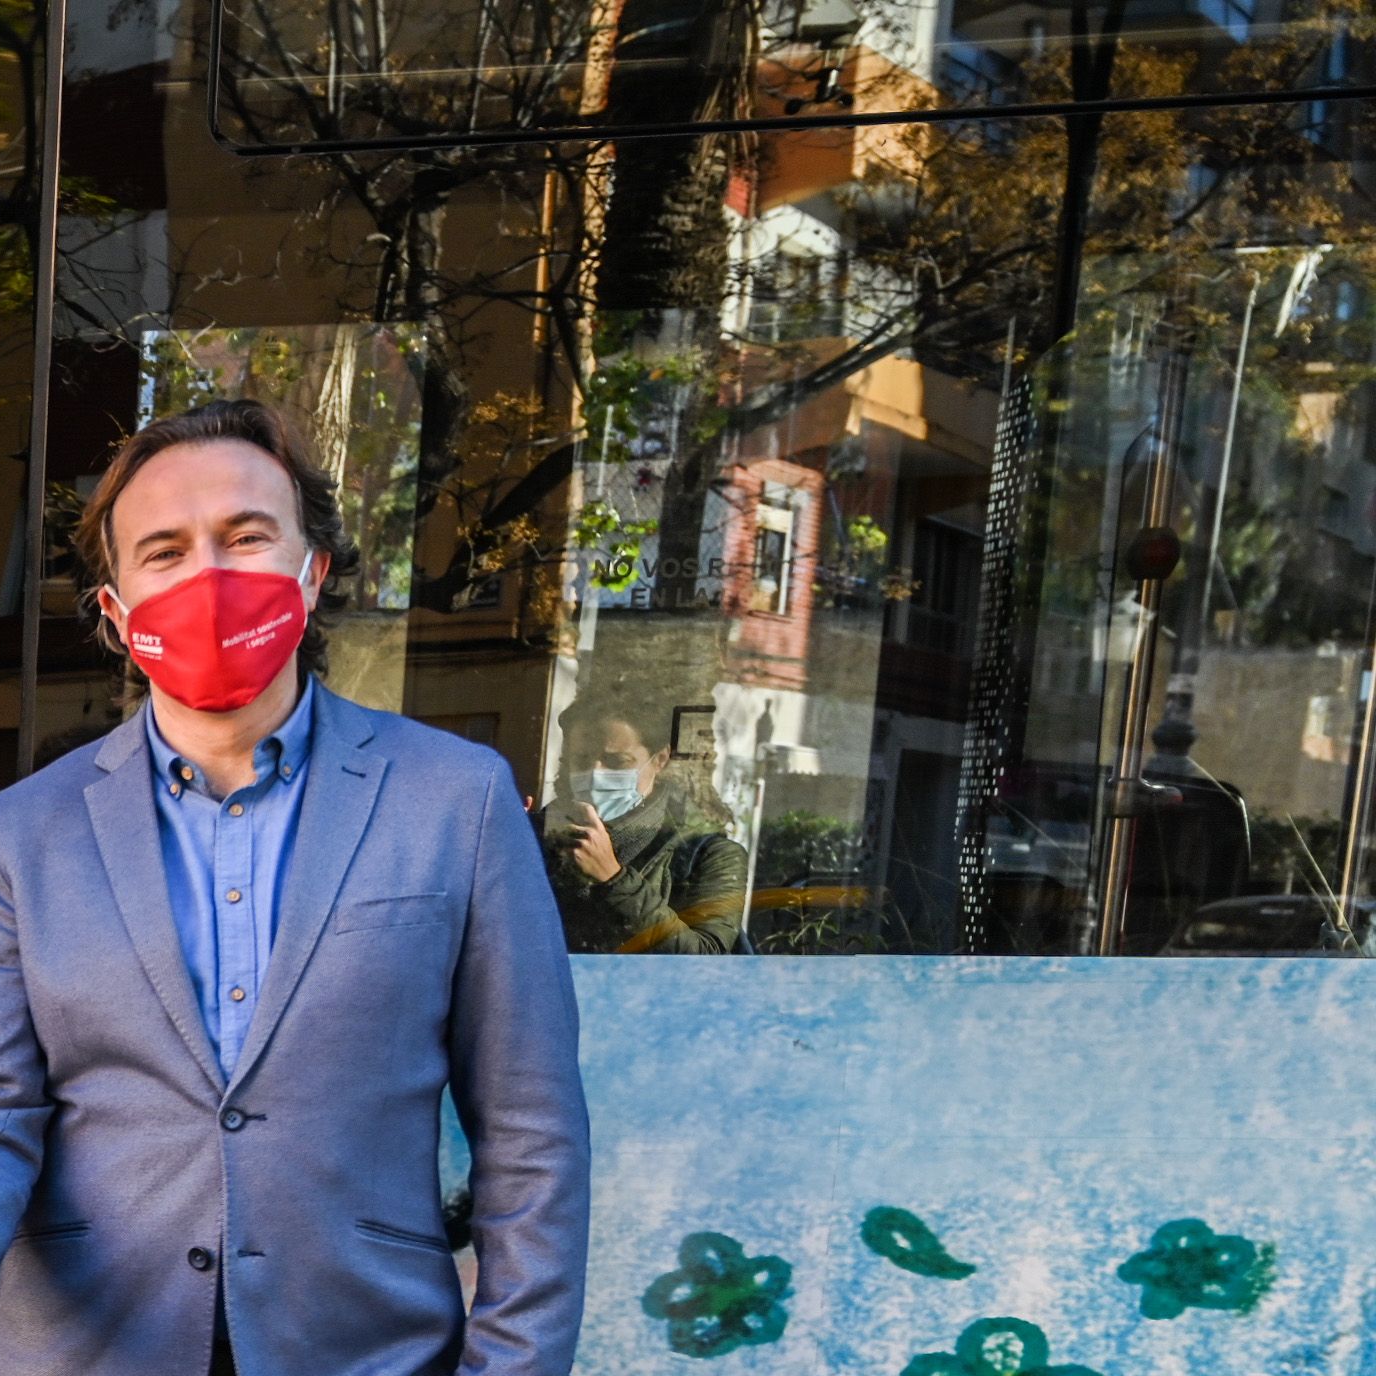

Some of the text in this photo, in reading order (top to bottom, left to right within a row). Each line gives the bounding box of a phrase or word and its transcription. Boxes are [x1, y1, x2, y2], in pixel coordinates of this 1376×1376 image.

[594, 557, 633, 578] NO
[643, 557, 698, 579] VOS
[631, 587, 667, 608] EN
[132, 632, 161, 646] EMT
